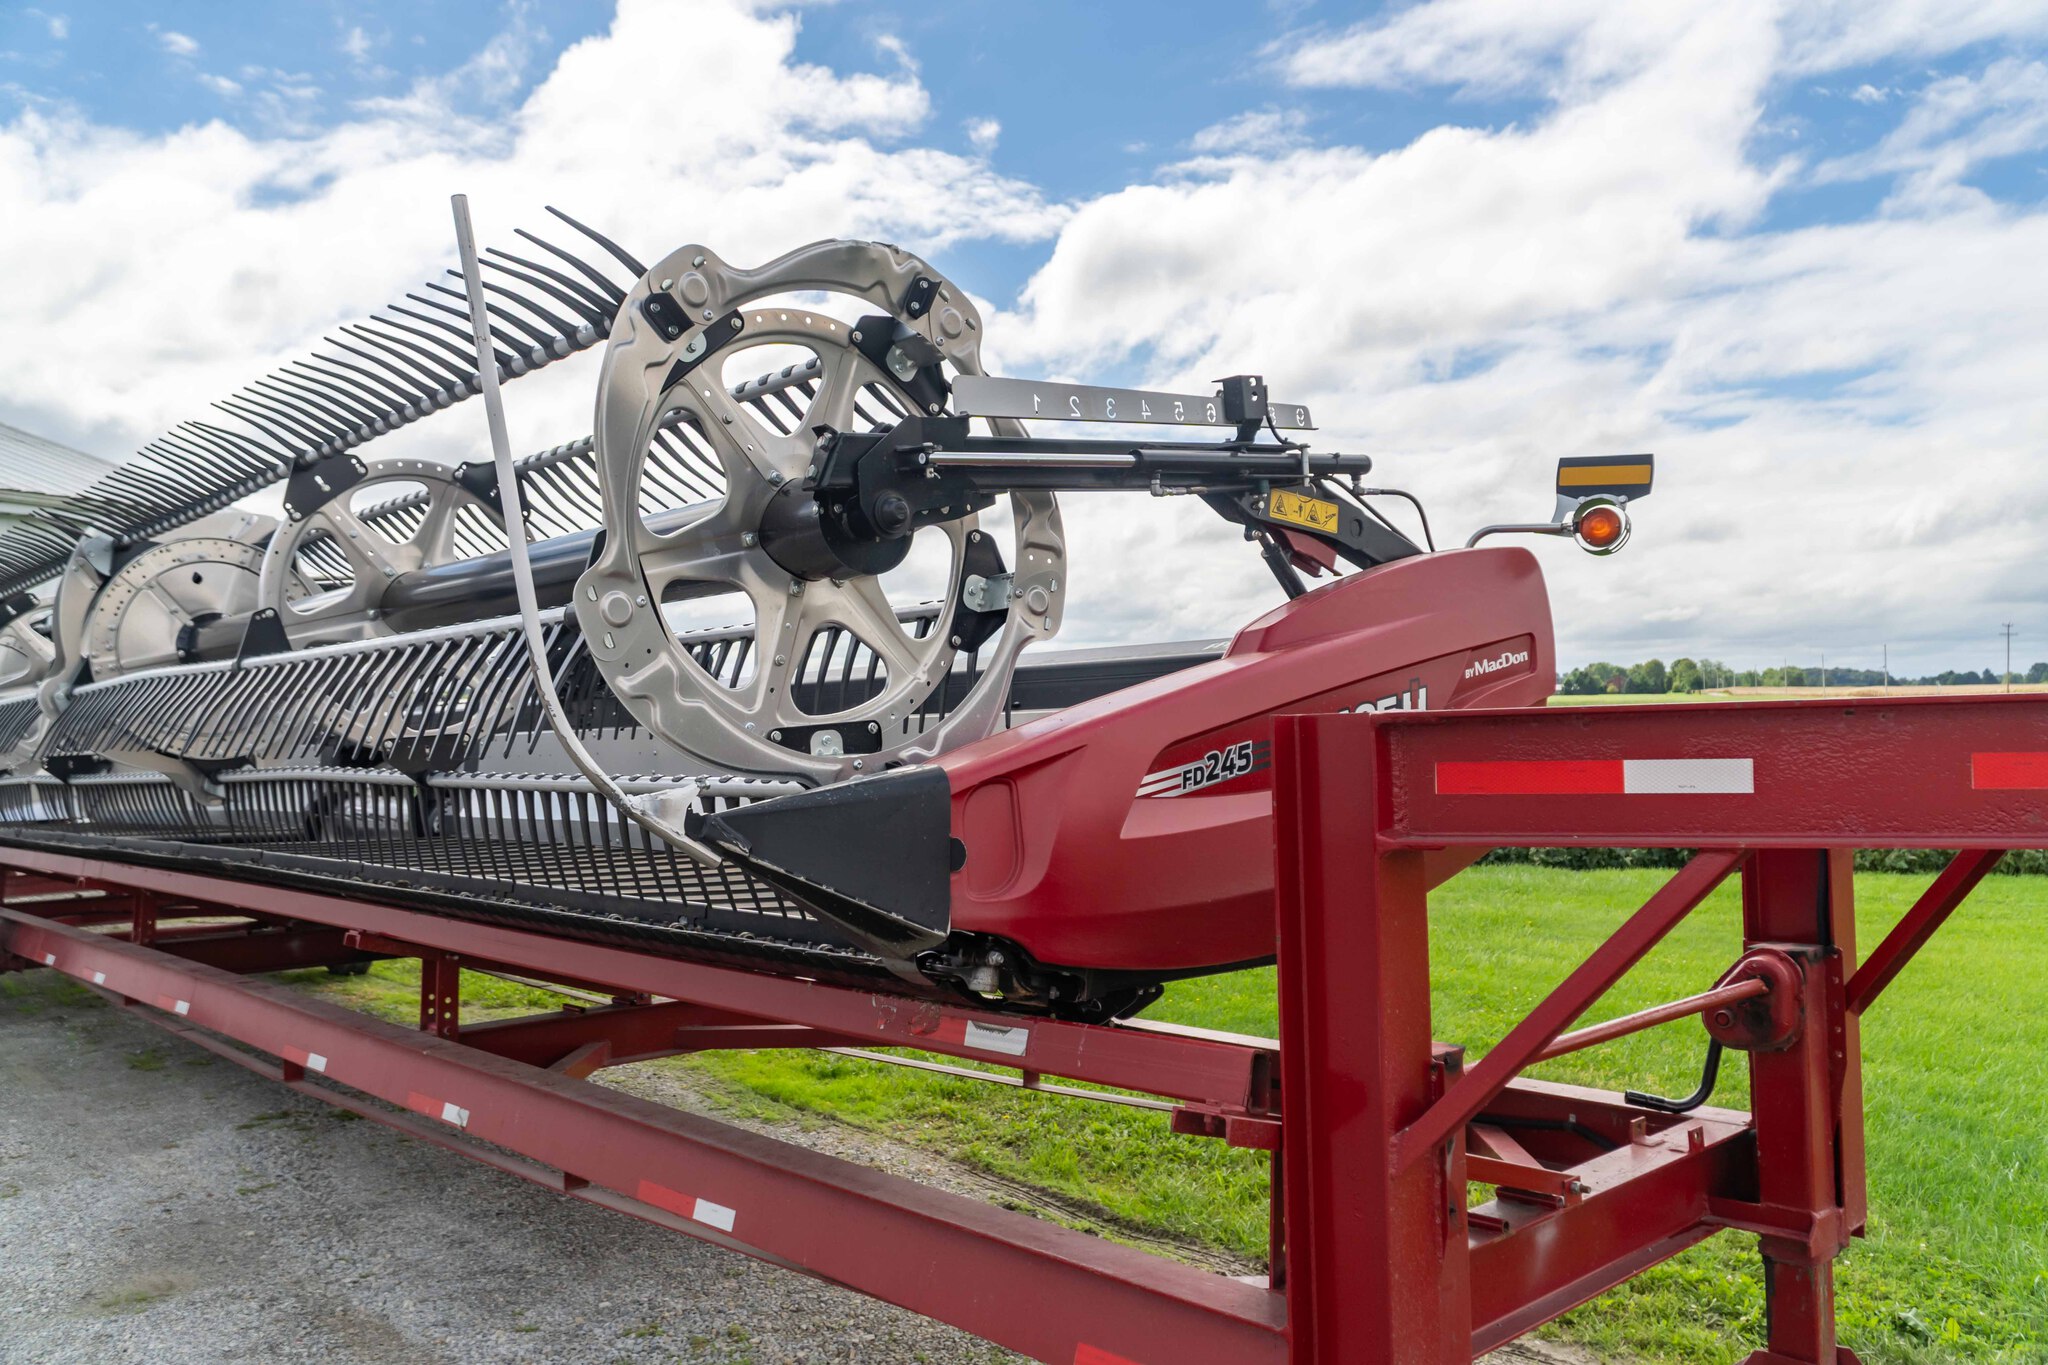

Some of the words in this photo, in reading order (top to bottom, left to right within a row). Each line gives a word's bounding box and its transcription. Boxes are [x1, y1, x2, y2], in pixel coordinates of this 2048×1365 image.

[1465, 667, 1475, 679] BY
[1474, 651, 1529, 676] MacDon
[1181, 740, 1254, 791] FD245
